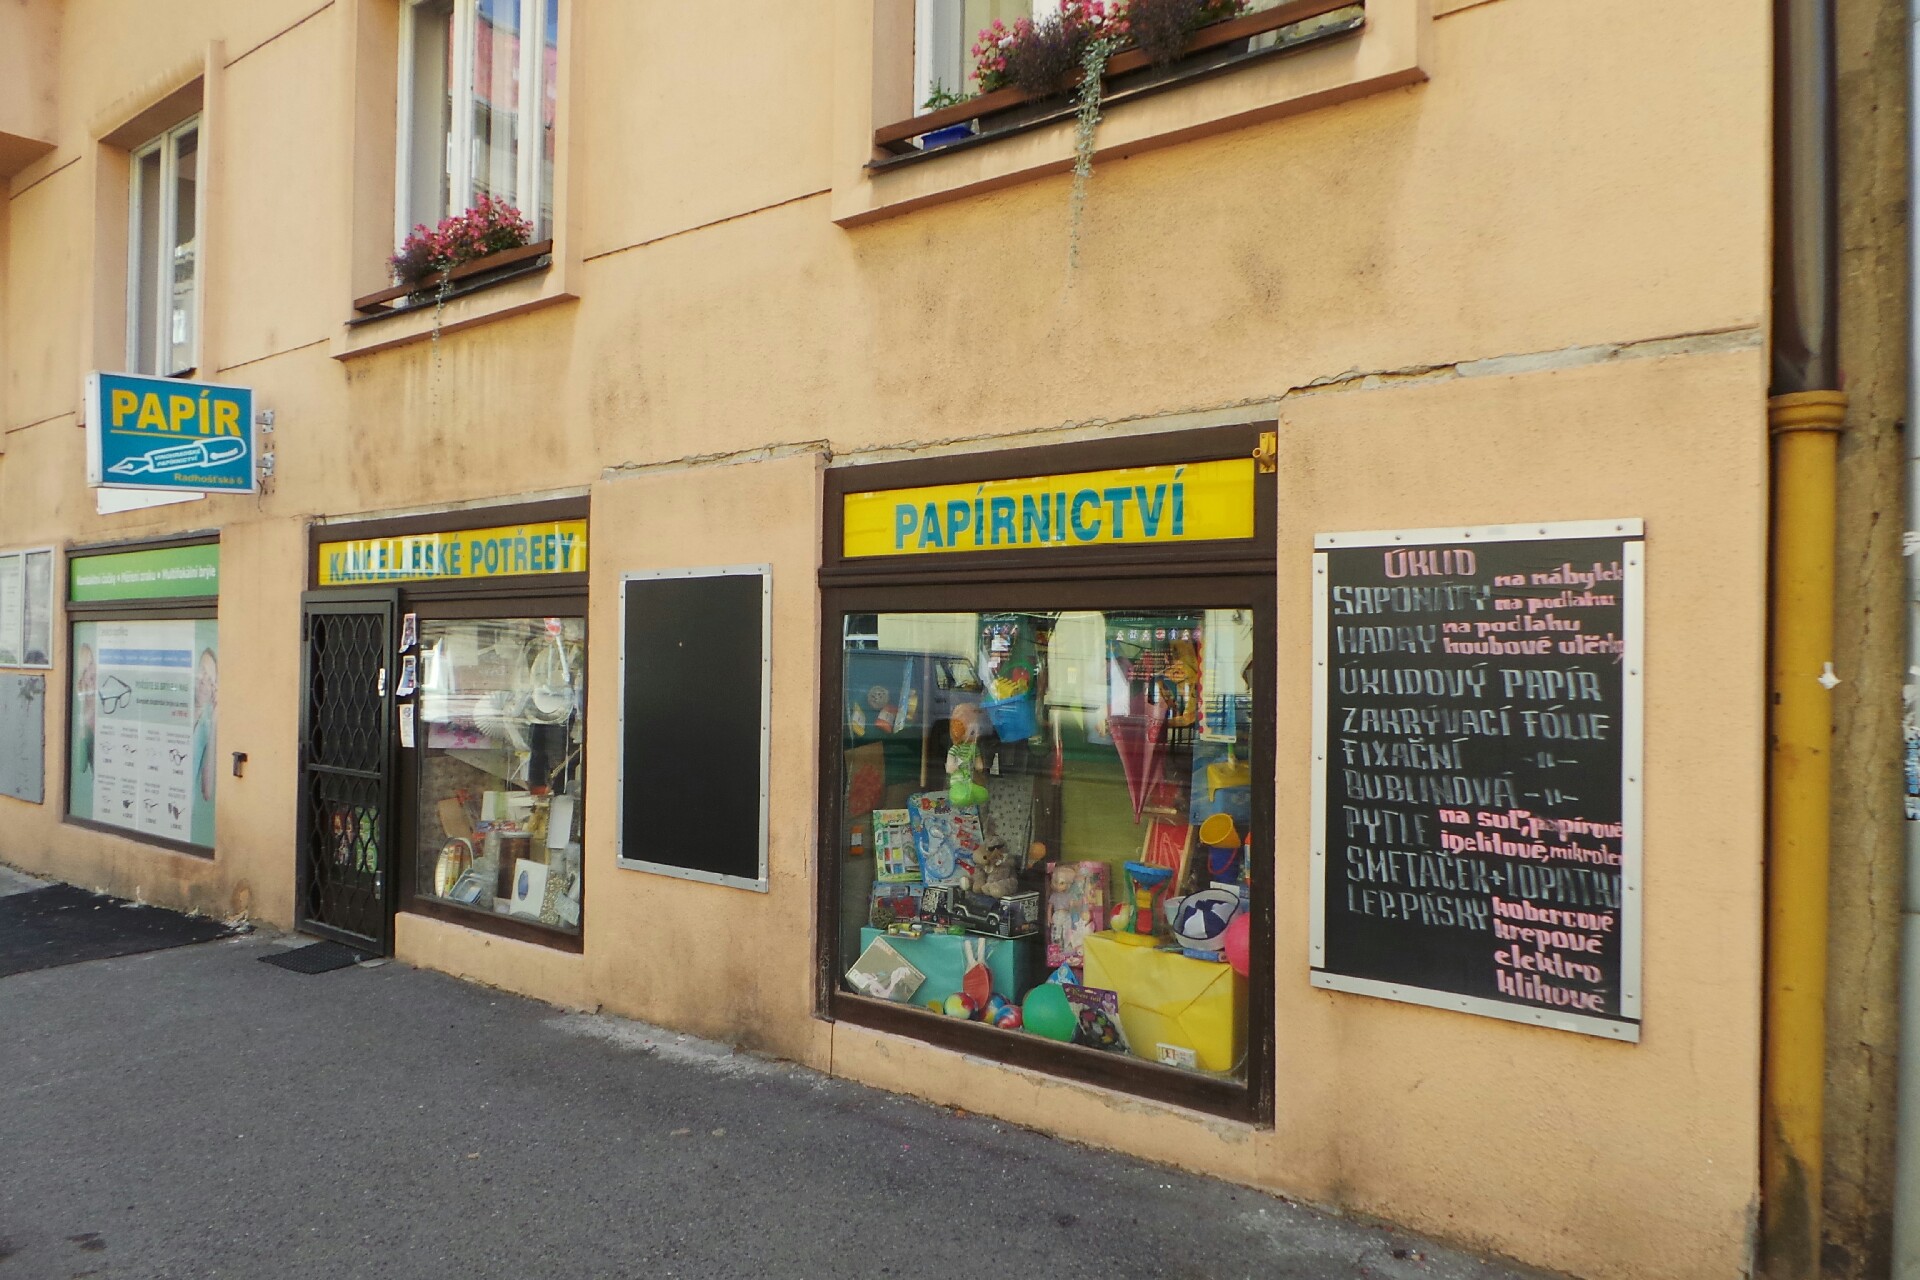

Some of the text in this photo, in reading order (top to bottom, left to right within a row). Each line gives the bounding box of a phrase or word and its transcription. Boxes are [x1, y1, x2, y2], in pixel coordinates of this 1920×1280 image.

[112, 389, 242, 437] PAPÍR
[895, 468, 1185, 549] PAPÍRNICTVÍ
[470, 528, 575, 575] POTŘEBY
[1384, 548, 1476, 578] ÚKLID
[1494, 574, 1525, 587] na
[1494, 590, 1617, 614] na podlahu
[1337, 624, 1436, 654] HADRY
[1442, 613, 1581, 638] na podlahu
[1442, 634, 1552, 656] houbové
[1338, 662, 1603, 701] ÚKLIDOVÝ PAPÍR
[1341, 704, 1611, 741] ZAKRÝVACÍ FÓLIE
[1340, 736, 1470, 771] FIXAČNÍ
[1343, 768, 1519, 809] BUBLINOVÁ
[1342, 804, 1431, 847] PYTLE
[1439, 808, 1471, 825] na
[1491, 896, 1614, 933] kobercové
[1493, 918, 1604, 955] krepové
[1494, 944, 1603, 984] elektro
[1496, 969, 1607, 1013] klihové
